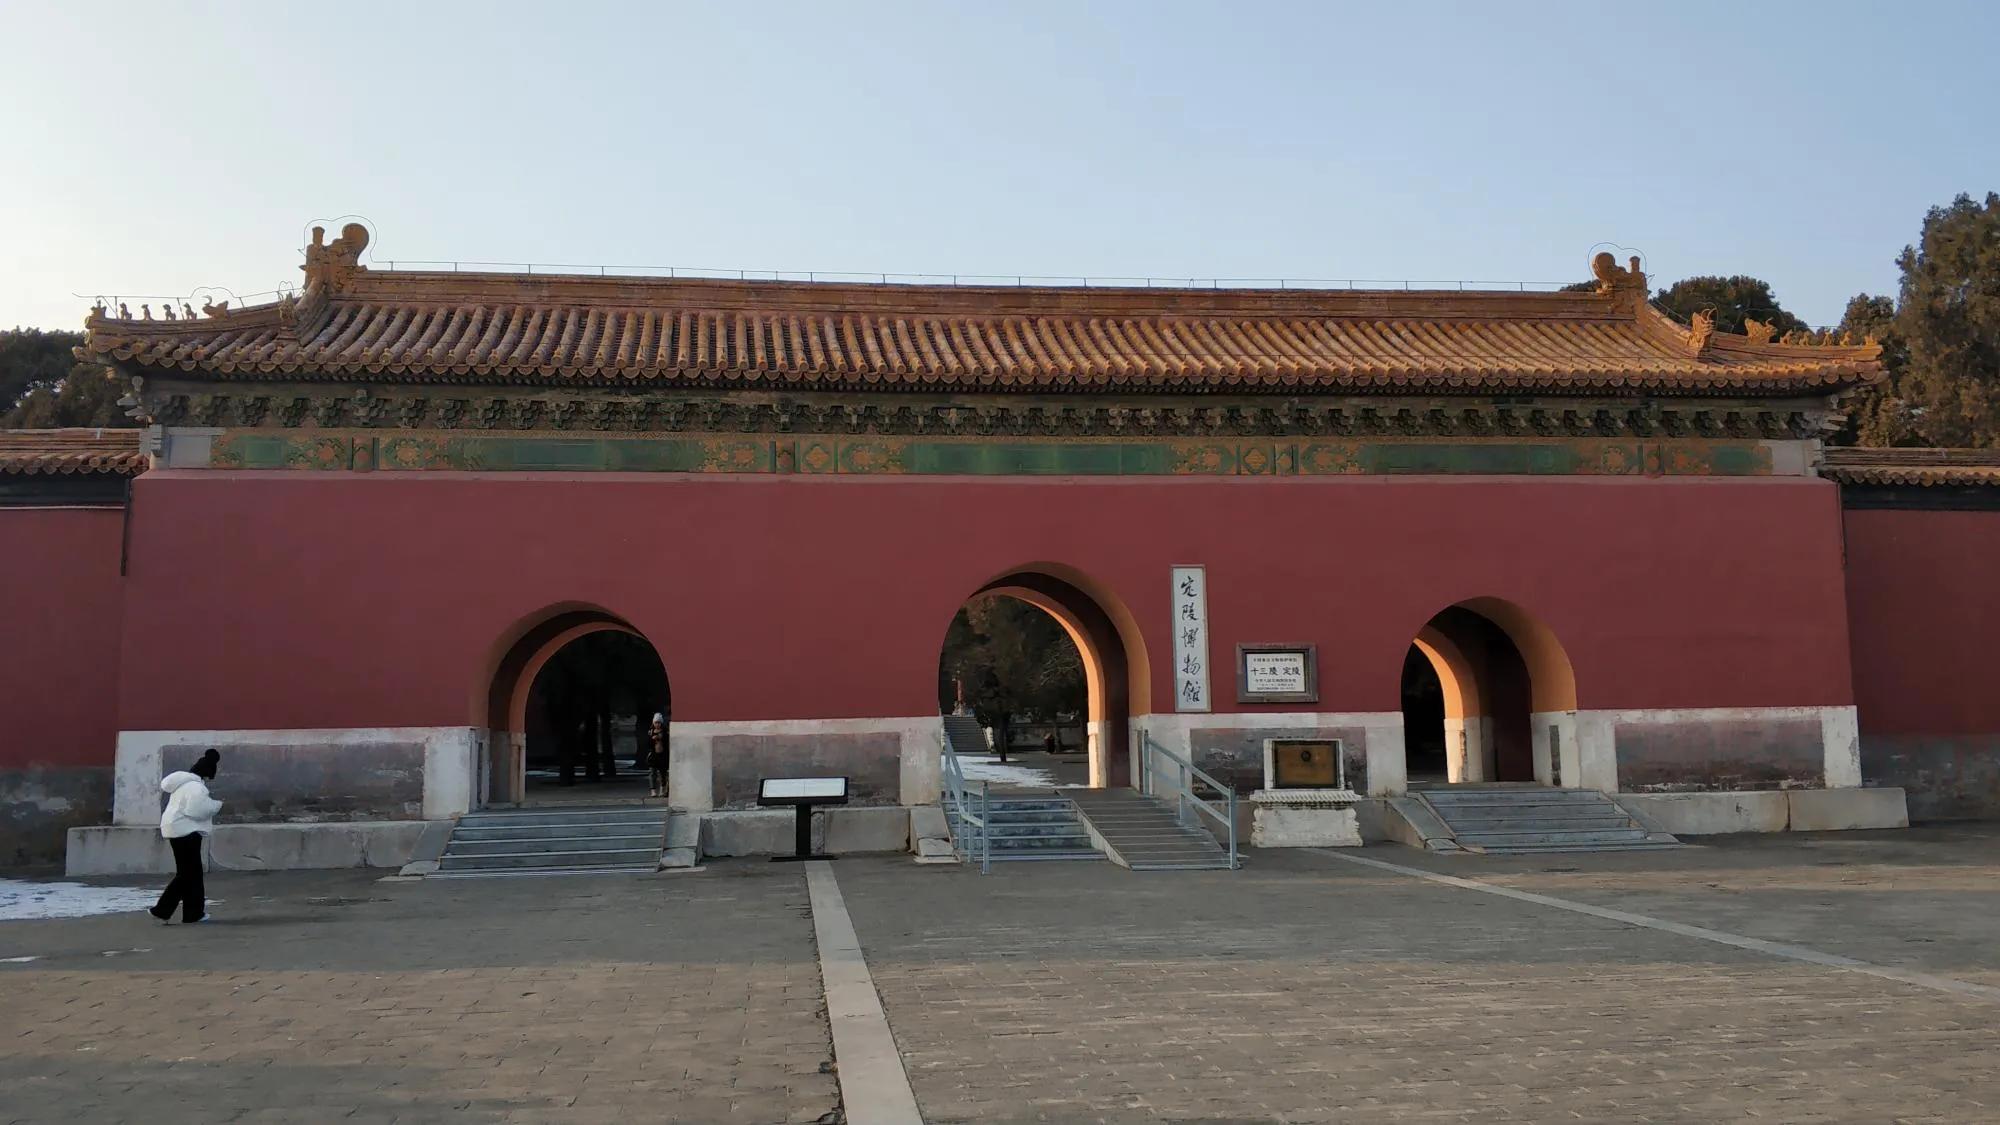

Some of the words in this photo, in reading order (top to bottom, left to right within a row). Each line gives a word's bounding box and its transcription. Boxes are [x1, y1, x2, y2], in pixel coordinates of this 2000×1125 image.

[1250, 666, 1278, 676] 十三陵
[1282, 666, 1301, 676] 定陵
